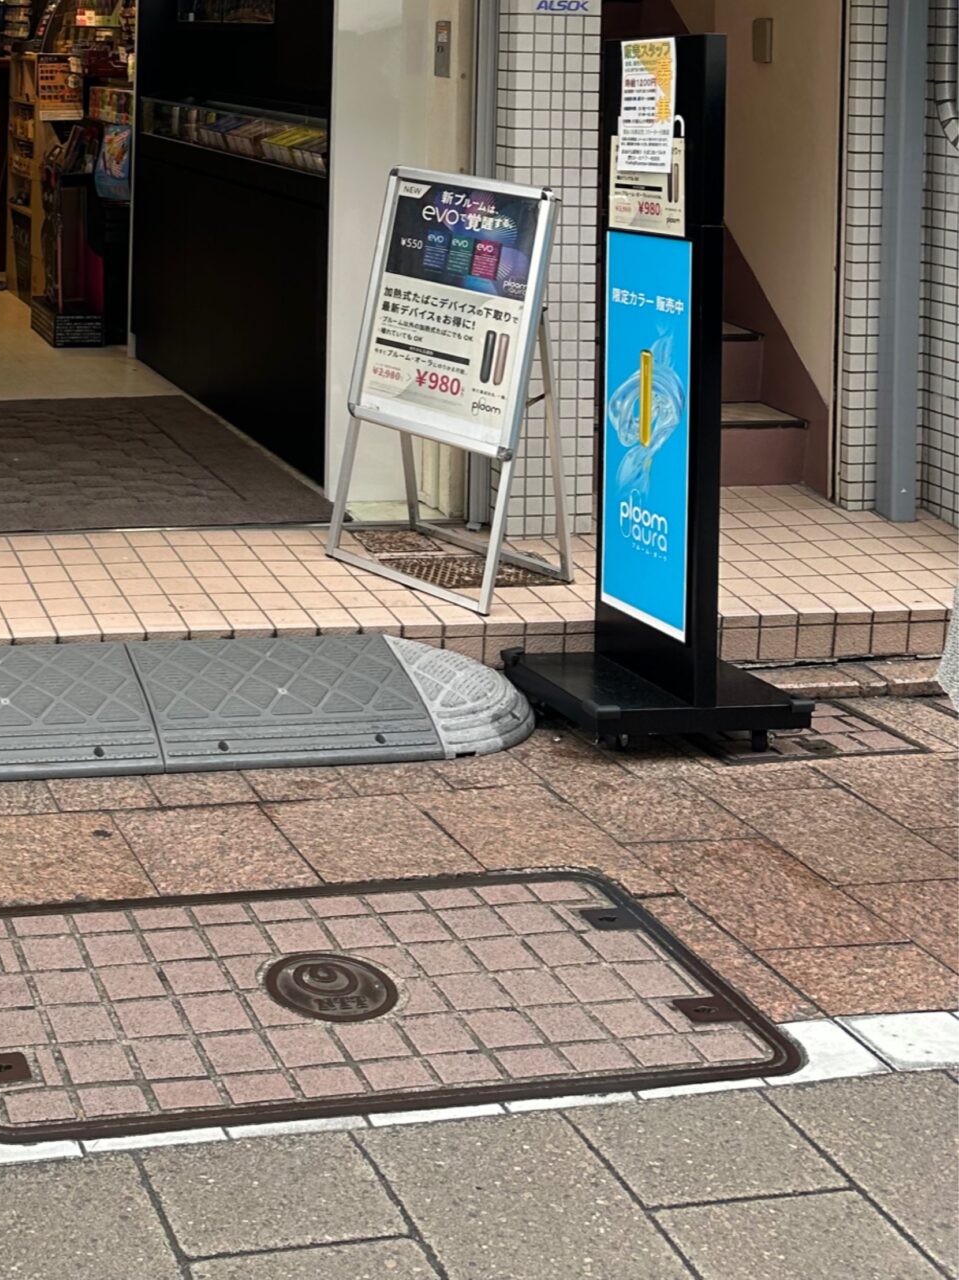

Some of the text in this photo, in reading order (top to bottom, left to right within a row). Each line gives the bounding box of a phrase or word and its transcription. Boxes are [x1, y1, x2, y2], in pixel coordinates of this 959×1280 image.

[536, 0, 589, 11] ALSOK
[403, 185, 423, 195] NEW
[639, 201, 661, 216] ¥980
[400, 236, 423, 250] ¥550
[427, 233, 445, 244] evo
[451, 238, 469, 248] evo
[476, 243, 494, 253] evo
[384, 286, 519, 324] 加熱式たばこデバイスの下取りで
[612, 287, 684, 315] 限定カラー 販売中
[415, 368, 461, 396] ¥980
[471, 397, 501, 416] ploom
[620, 488, 668, 538] ploom
[632, 524, 668, 553] aura
[313, 995, 369, 1011] NTT
